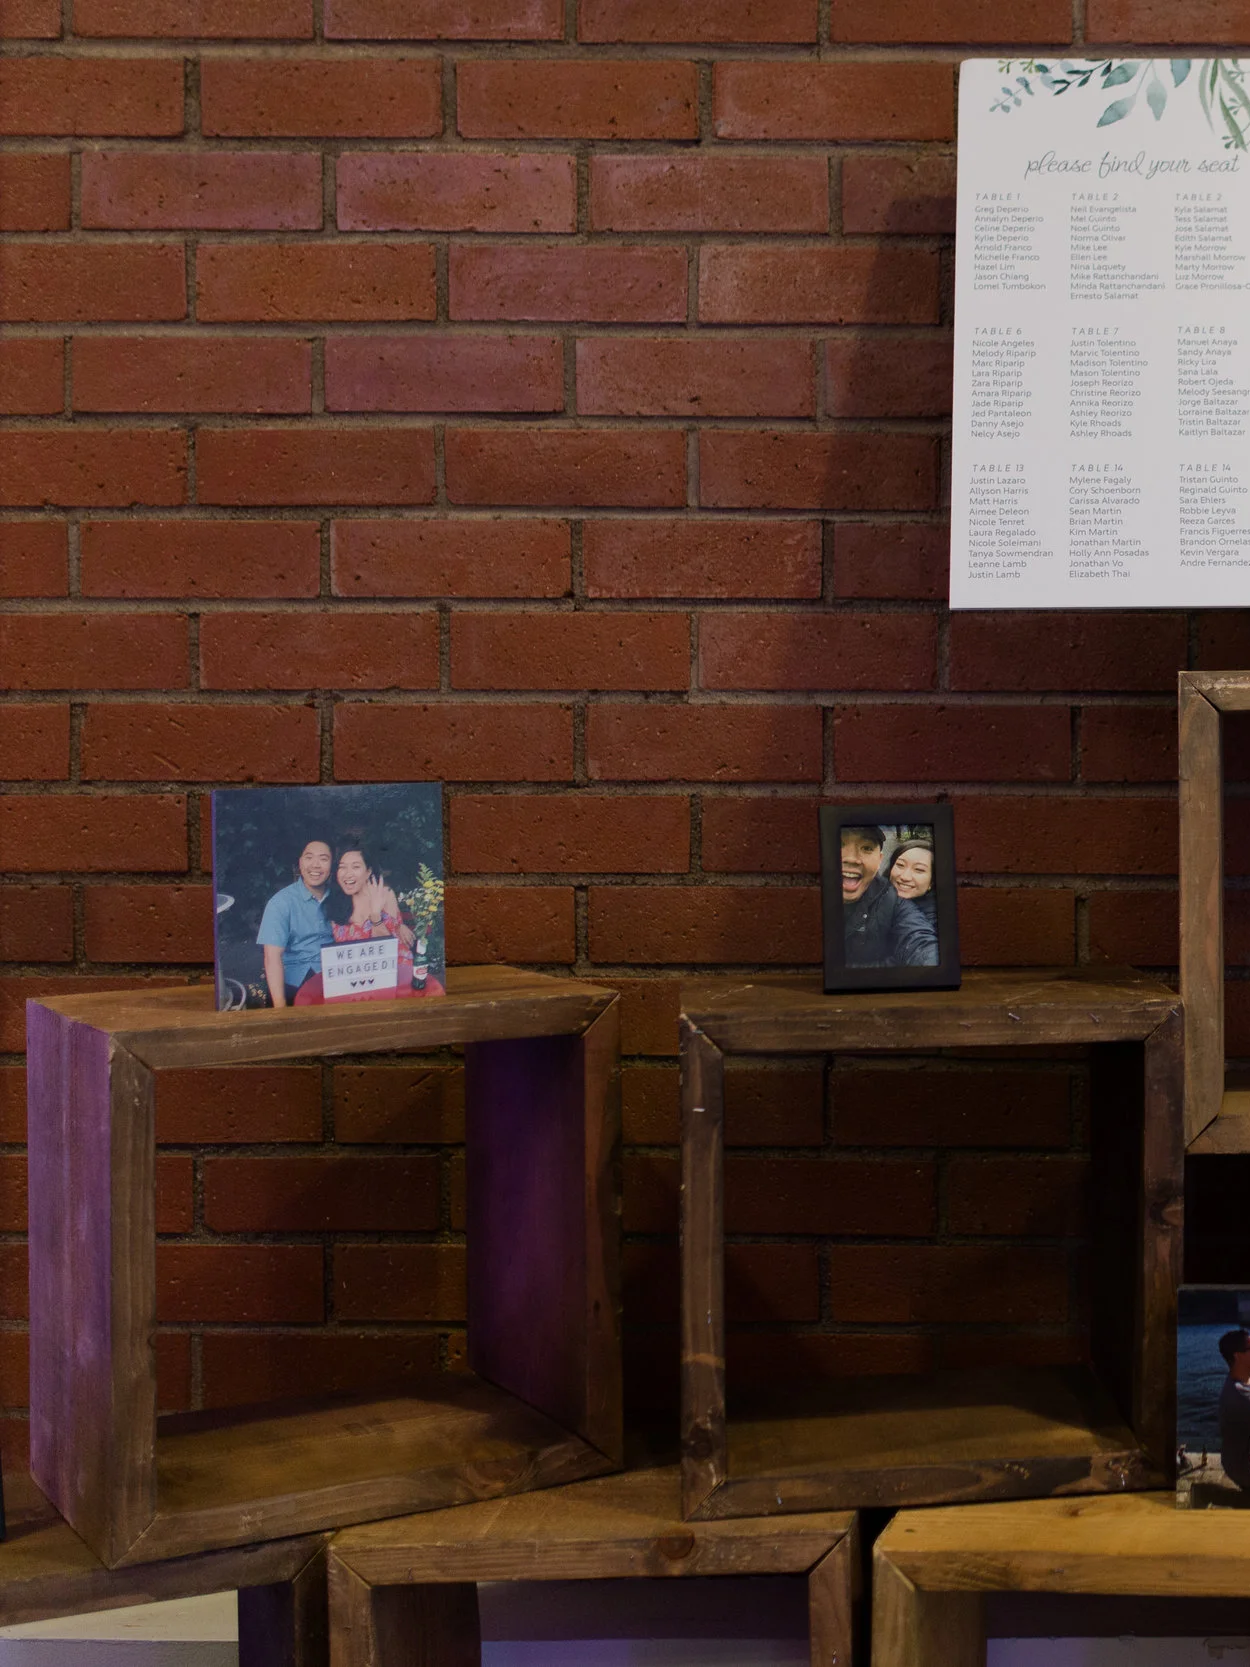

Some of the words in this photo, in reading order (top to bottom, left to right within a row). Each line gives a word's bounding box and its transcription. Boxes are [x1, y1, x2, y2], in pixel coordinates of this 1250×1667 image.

[1024, 150, 1092, 180] please
[1098, 150, 1146, 178] find
[1146, 156, 1192, 180] your
[1197, 152, 1240, 174] seat
[1089, 205, 1136, 215] Evangelista
[1001, 339, 1034, 349] Angeles
[1211, 338, 1238, 348] Anaya
[992, 370, 1022, 379] Riparip
[1208, 378, 1233, 388] Ojeda
[1179, 486, 1216, 496] Reginald
[336, 949, 352, 960] WE
[360, 944, 384, 957] ARE
